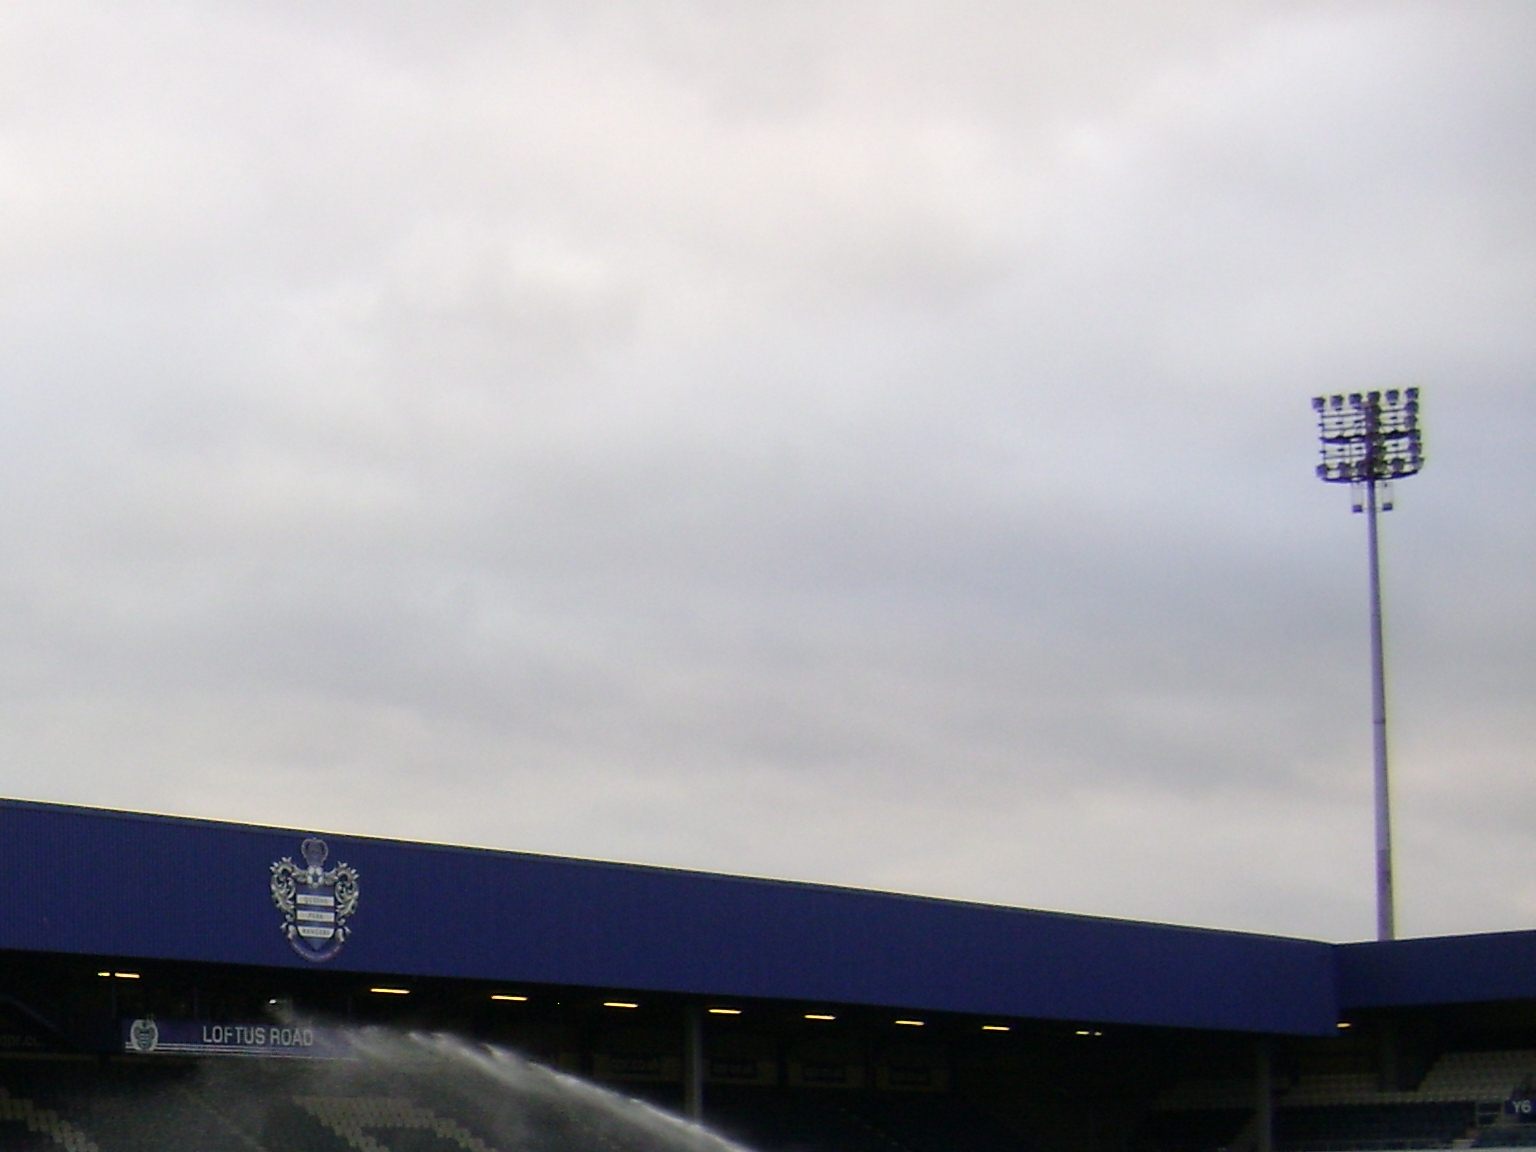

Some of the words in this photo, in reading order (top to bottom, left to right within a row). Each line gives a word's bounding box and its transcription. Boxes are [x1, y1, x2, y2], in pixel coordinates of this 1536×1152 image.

[202, 1025, 265, 1045] LOFTUS
[270, 1027, 313, 1047] ROAD
[1512, 1099, 1532, 1114] Y6
